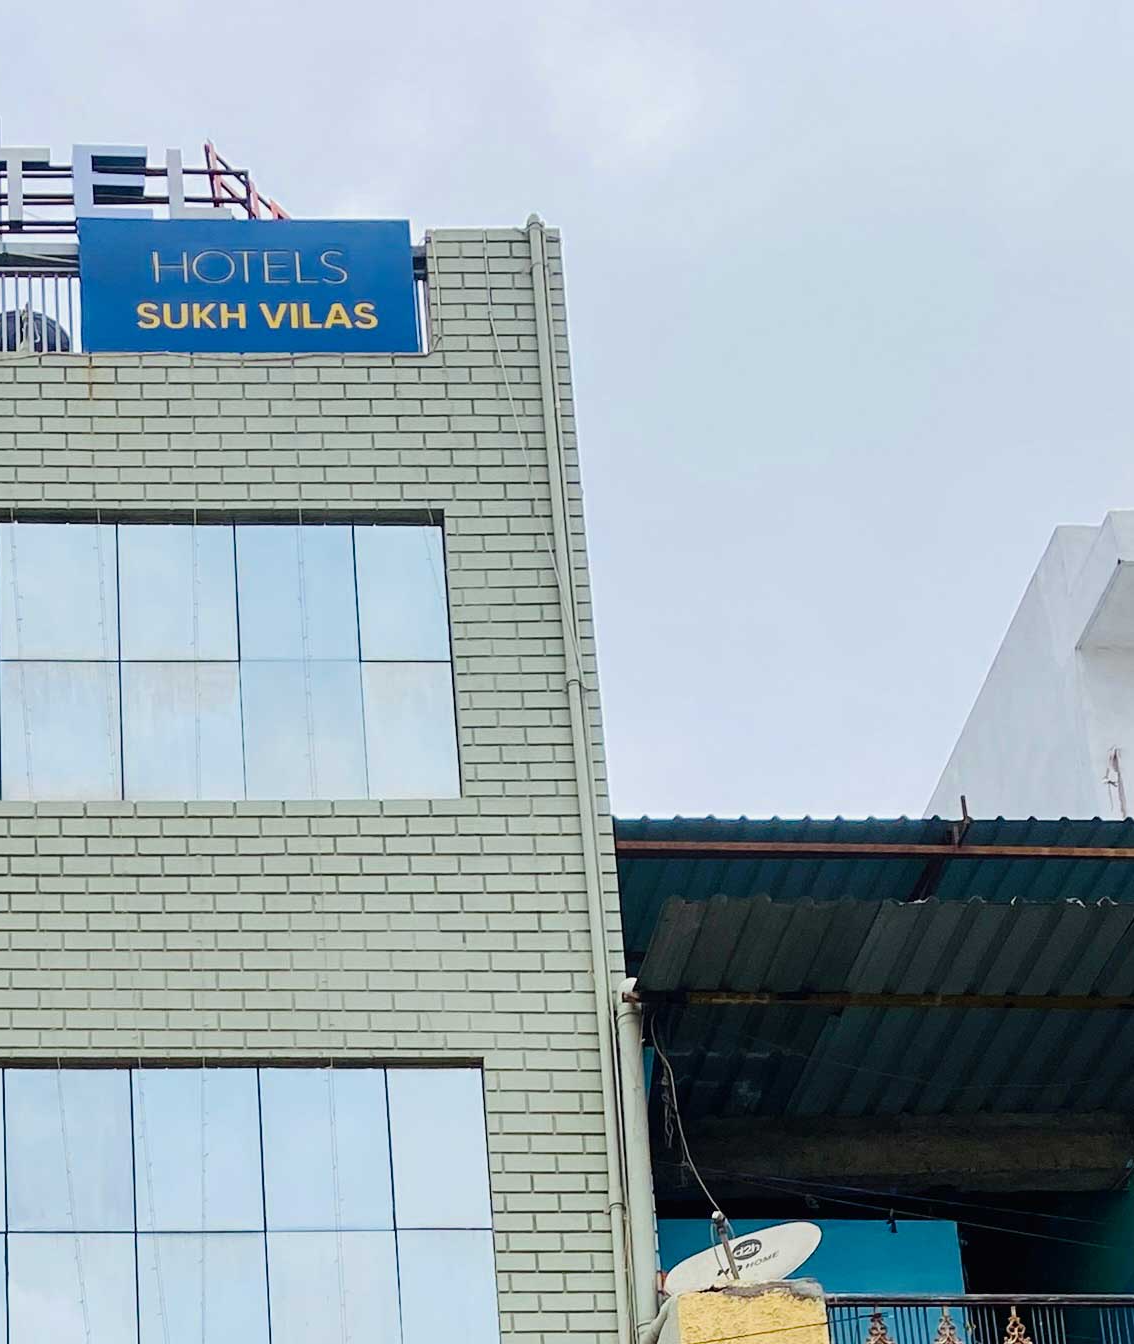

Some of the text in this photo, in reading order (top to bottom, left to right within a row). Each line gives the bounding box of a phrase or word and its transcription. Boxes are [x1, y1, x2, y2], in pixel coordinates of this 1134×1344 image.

[151, 249, 349, 286] HOTELS
[135, 301, 380, 330] SUKH VILAS
[733, 1242, 762, 1258] d2h
[746, 1250, 780, 1270] HOME
